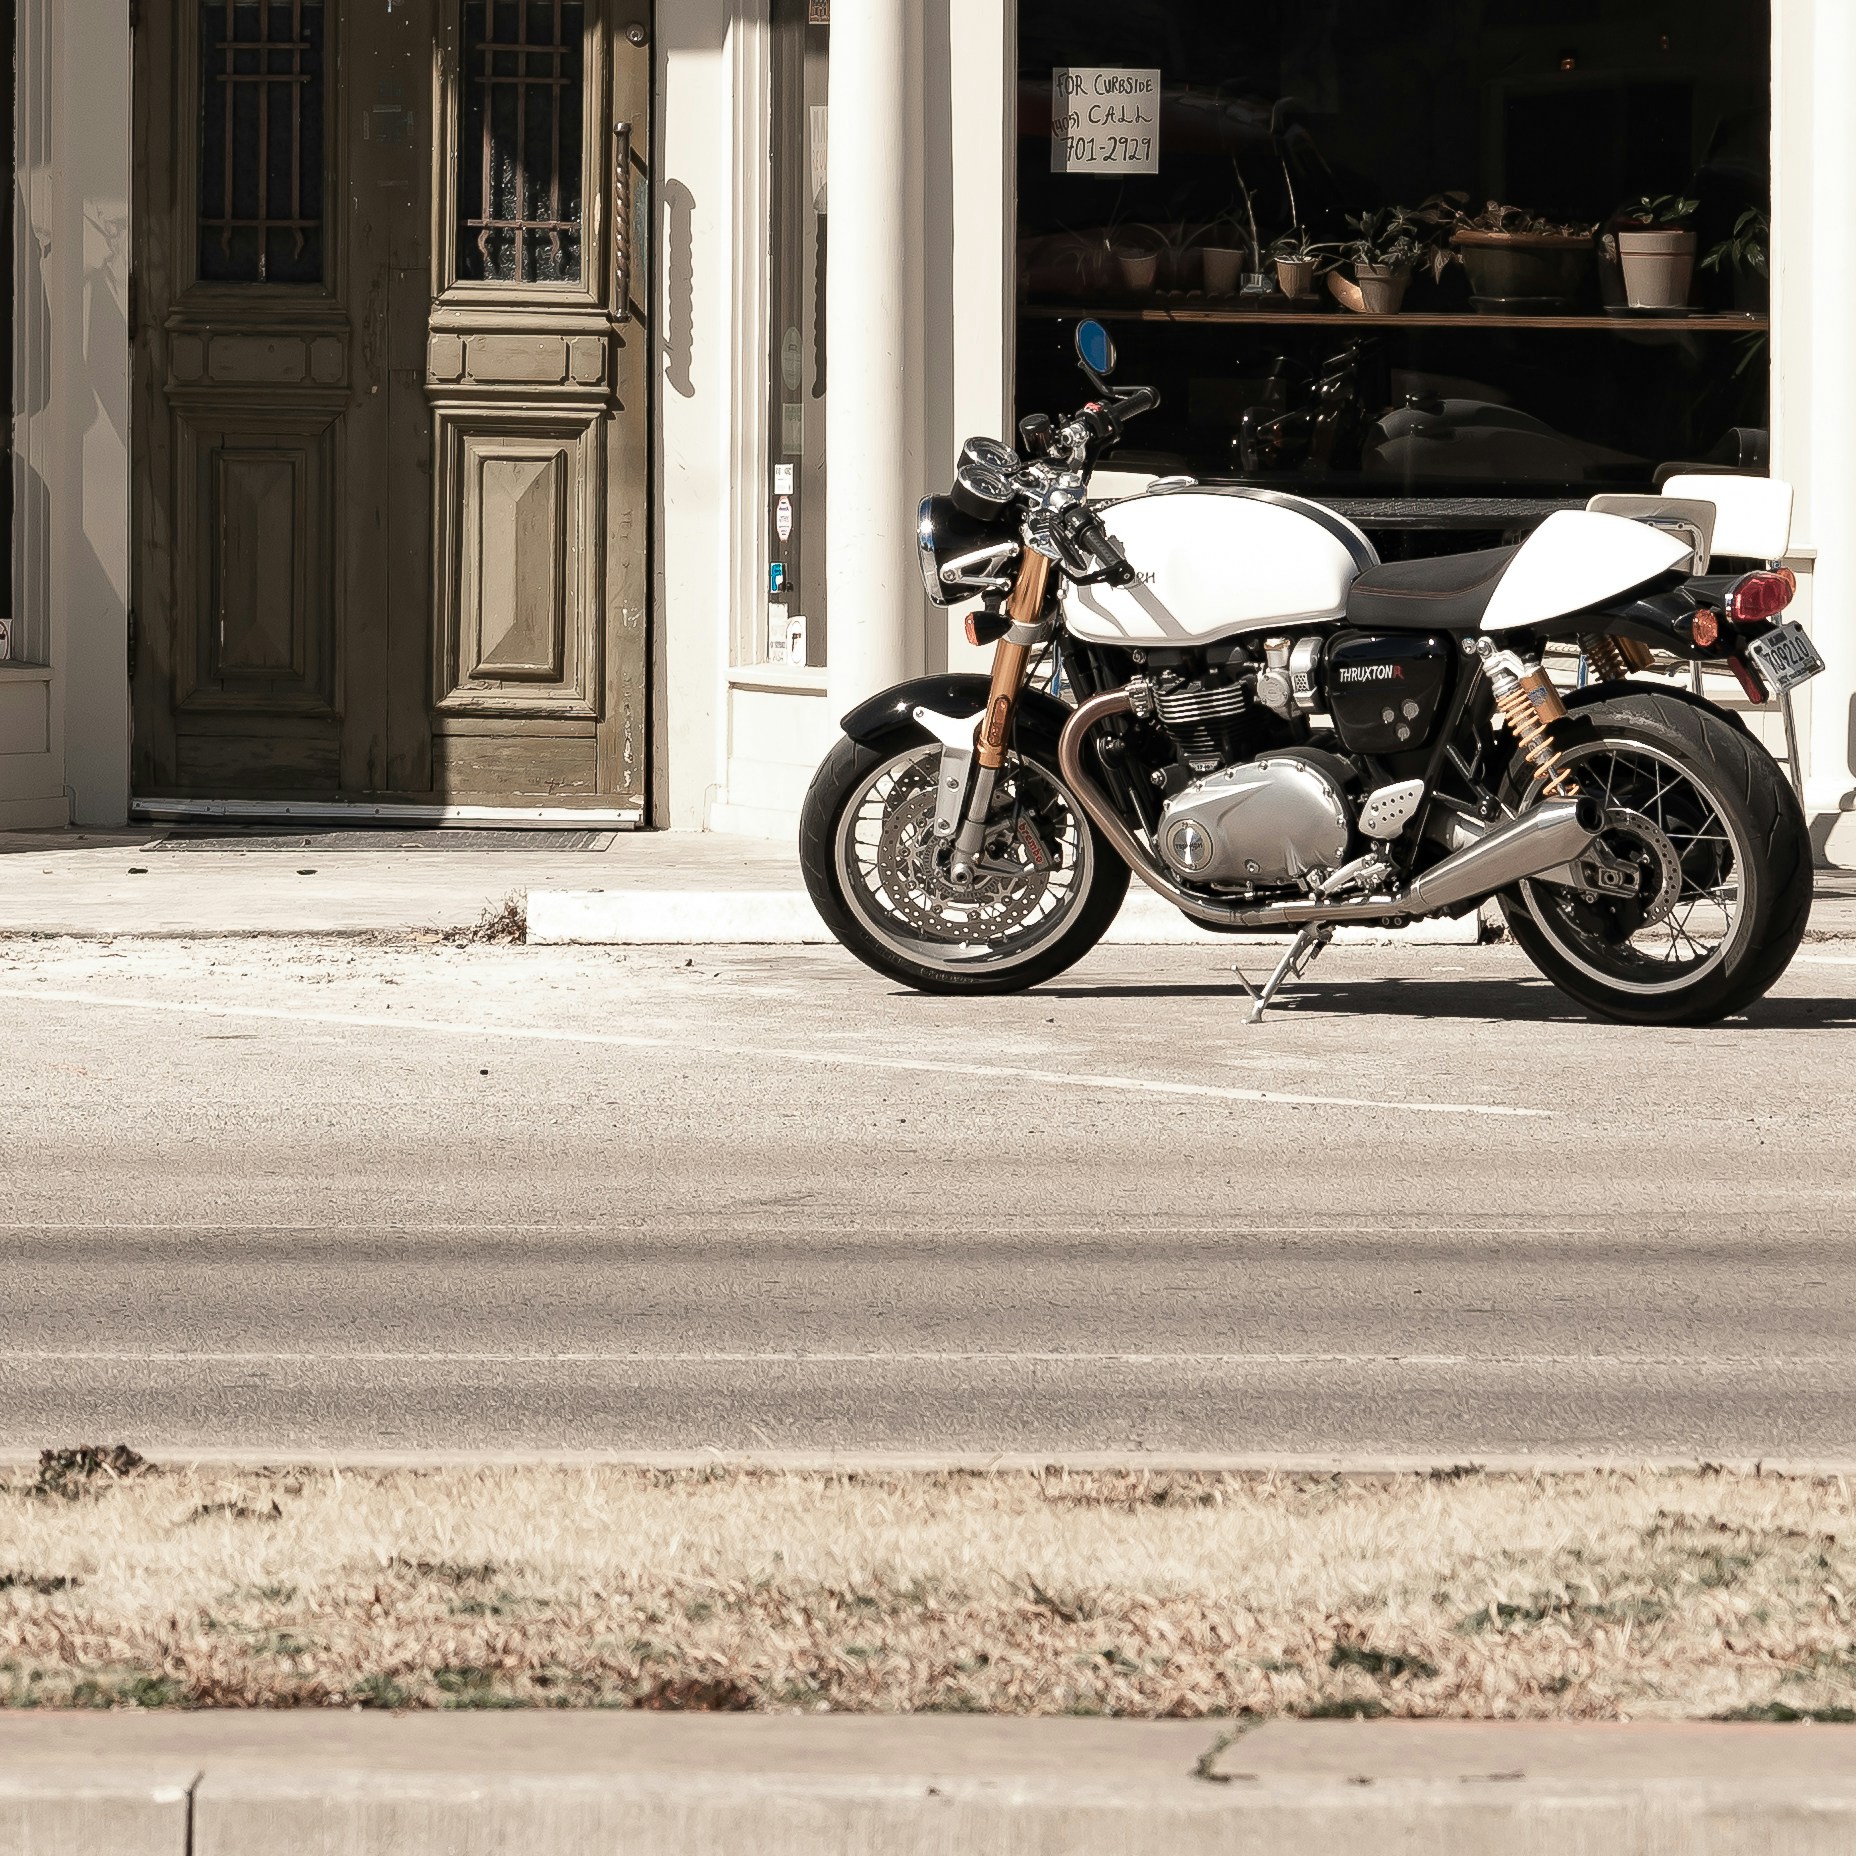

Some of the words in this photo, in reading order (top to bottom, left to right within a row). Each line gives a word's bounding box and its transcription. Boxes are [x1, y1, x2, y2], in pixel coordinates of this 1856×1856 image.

[1056, 71, 1089, 98] FOR
[1093, 73, 1154, 96] CURBSIDE
[1051, 110, 1081, 138] (405)
[1088, 104, 1153, 126] CALL
[1059, 135, 1152, 163] 701-2929
[1339, 664, 1394, 683] THRUXTON
[1018, 823, 1043, 863] brembo
